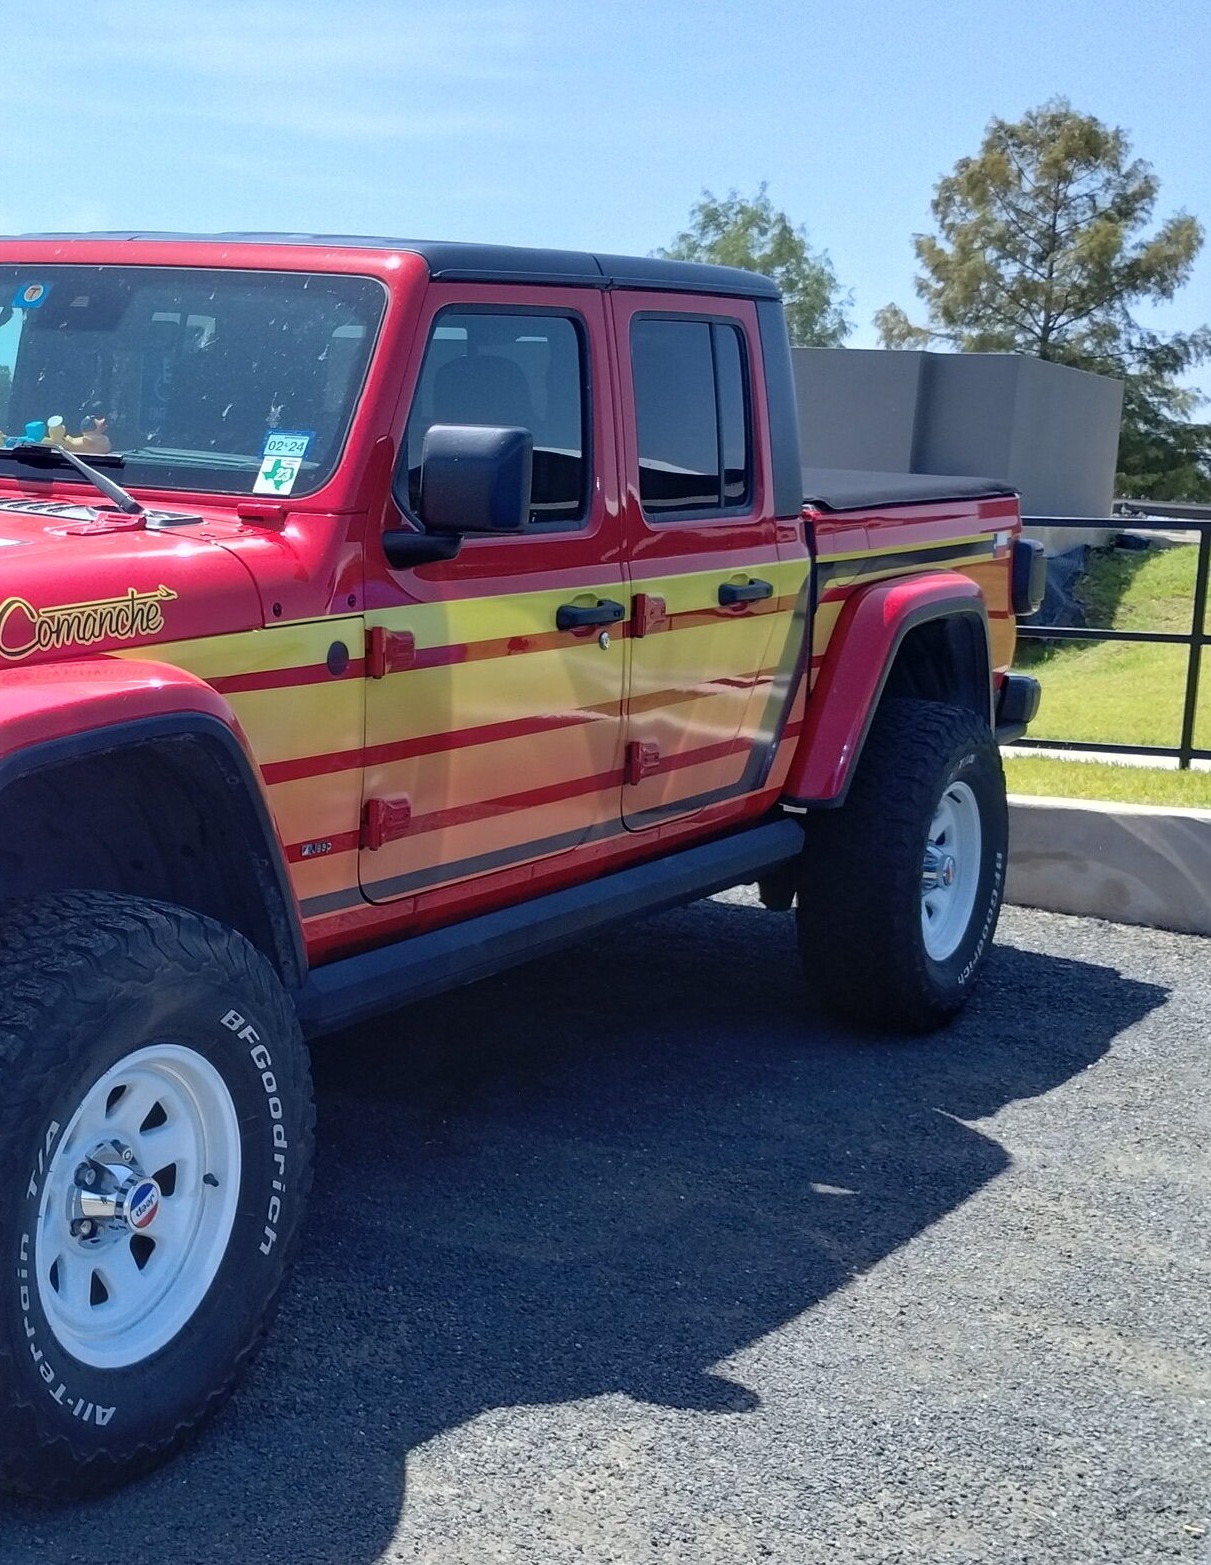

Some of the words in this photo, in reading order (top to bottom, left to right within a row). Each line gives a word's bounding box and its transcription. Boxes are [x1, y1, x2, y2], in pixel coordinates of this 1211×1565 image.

[274, 467, 291, 481] 23
[220, 1009, 291, 1257] BFGoodrich
[135, 1192, 156, 1217] Jeep
